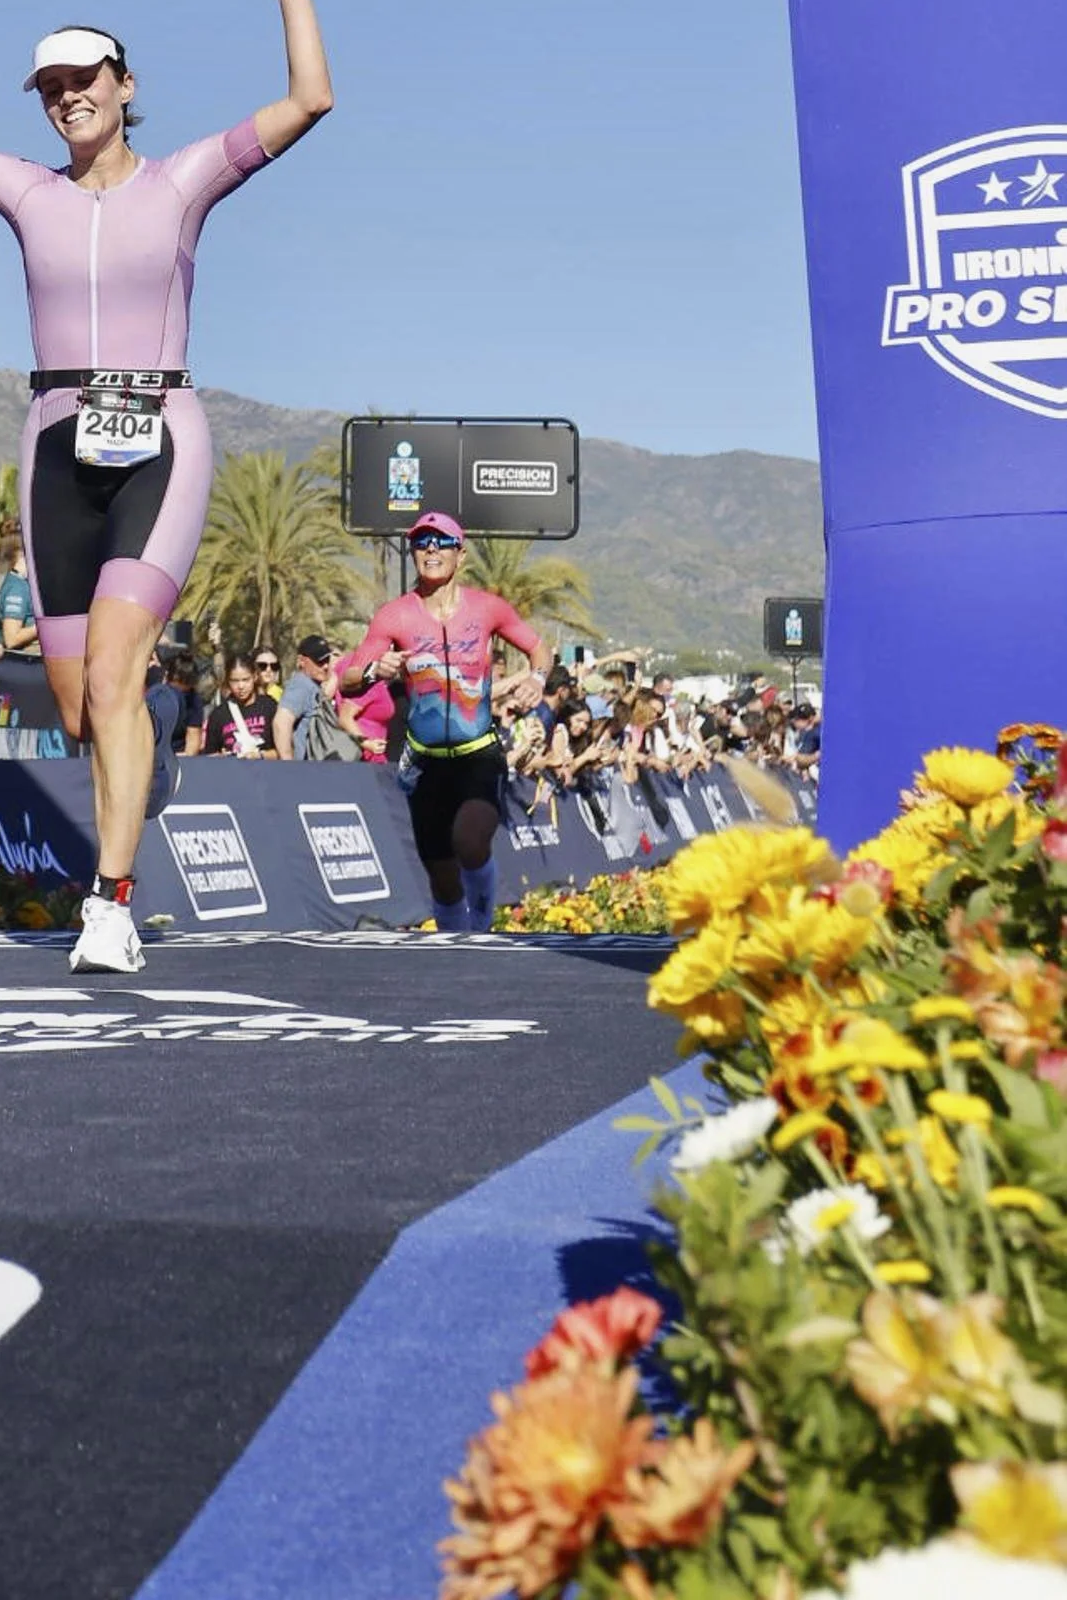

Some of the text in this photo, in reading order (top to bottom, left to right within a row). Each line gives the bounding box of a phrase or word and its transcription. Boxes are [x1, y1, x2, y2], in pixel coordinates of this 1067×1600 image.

[894, 289, 1007, 333] PRO
[84, 411, 153, 439] 2404
[479, 467, 552, 481] PRECISION
[388, 484, 421, 499] 70.3
